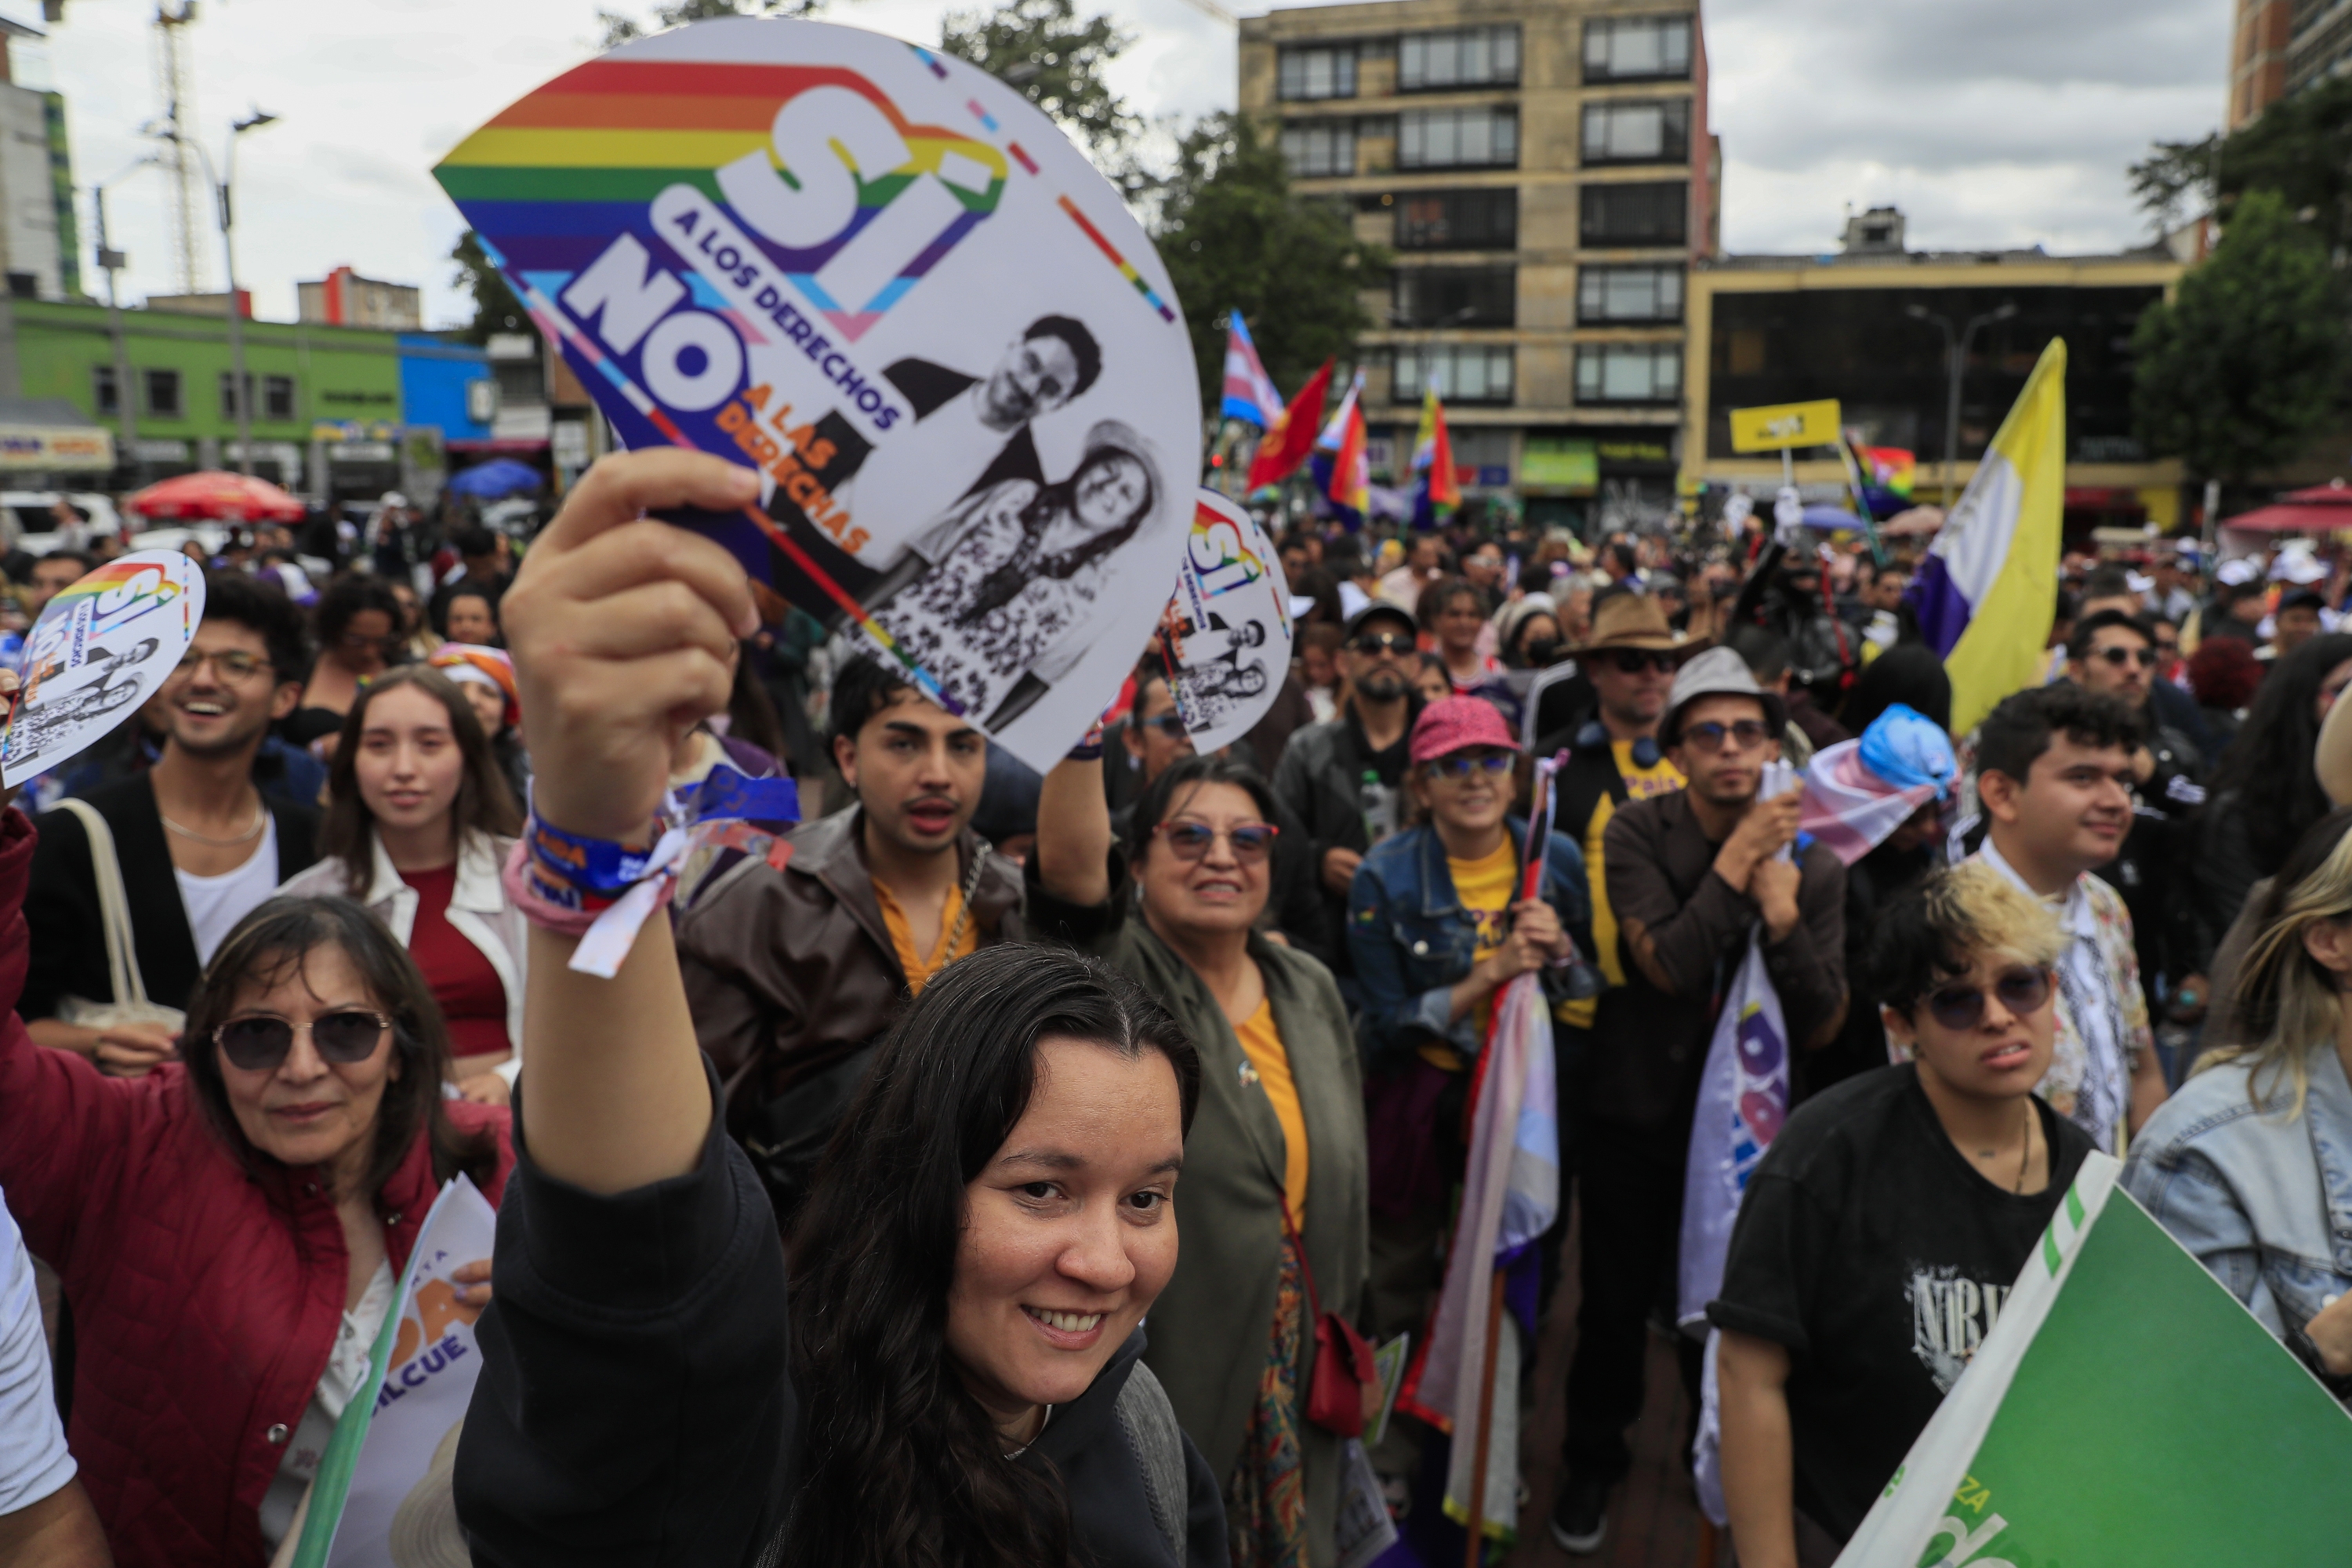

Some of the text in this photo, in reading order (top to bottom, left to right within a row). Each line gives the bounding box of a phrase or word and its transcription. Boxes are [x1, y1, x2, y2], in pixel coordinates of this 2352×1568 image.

[562, 231, 743, 412] NO
[672, 208, 902, 432] A LOS DERECHOS
[714, 383, 871, 555] A LAS DERECHAS
